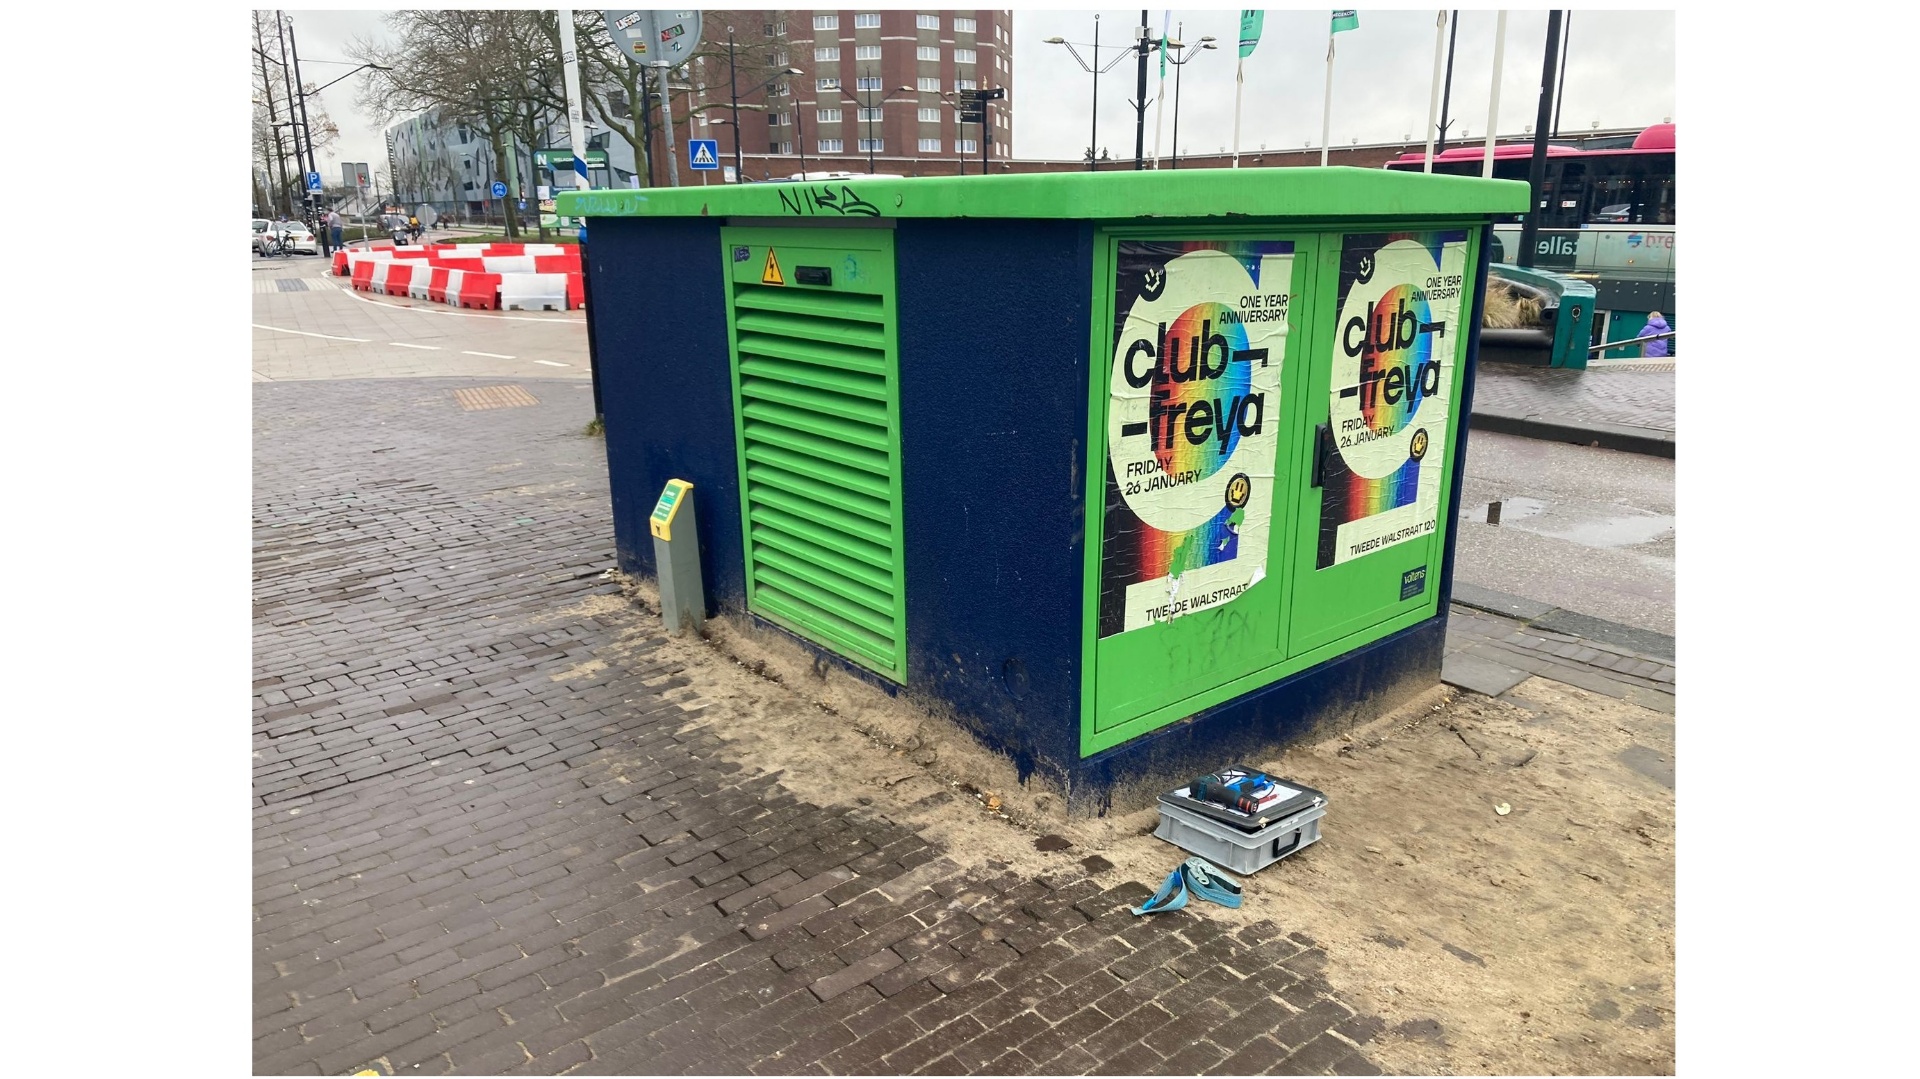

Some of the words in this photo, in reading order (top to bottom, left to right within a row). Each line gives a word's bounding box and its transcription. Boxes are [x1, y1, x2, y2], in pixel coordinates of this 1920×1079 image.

[310, 173, 318, 182] P
[1426, 277, 1442, 288] ONE
[1443, 275, 1462, 287] YEAR
[1240, 295, 1262, 308] ONE
[1263, 294, 1288, 307] YEAR
[1411, 287, 1461, 302] ANNIVERSARY
[1219, 309, 1288, 325] ANNIVERSARY
[1342, 415, 1374, 433] FRIDAY
[1340, 435, 1352, 449] 26
[1354, 425, 1395, 446] JANUARY
[1127, 456, 1173, 478] FRIDAY
[1125, 481, 1141, 496] 26
[1144, 469, 1202, 493] JANUARY
[1350, 537, 1381, 556] TWEEDE
[1381, 523, 1423, 546] WALSTRAAT
[1424, 519, 1436, 531] 120
[1146, 600, 1188, 621] TWEDE
